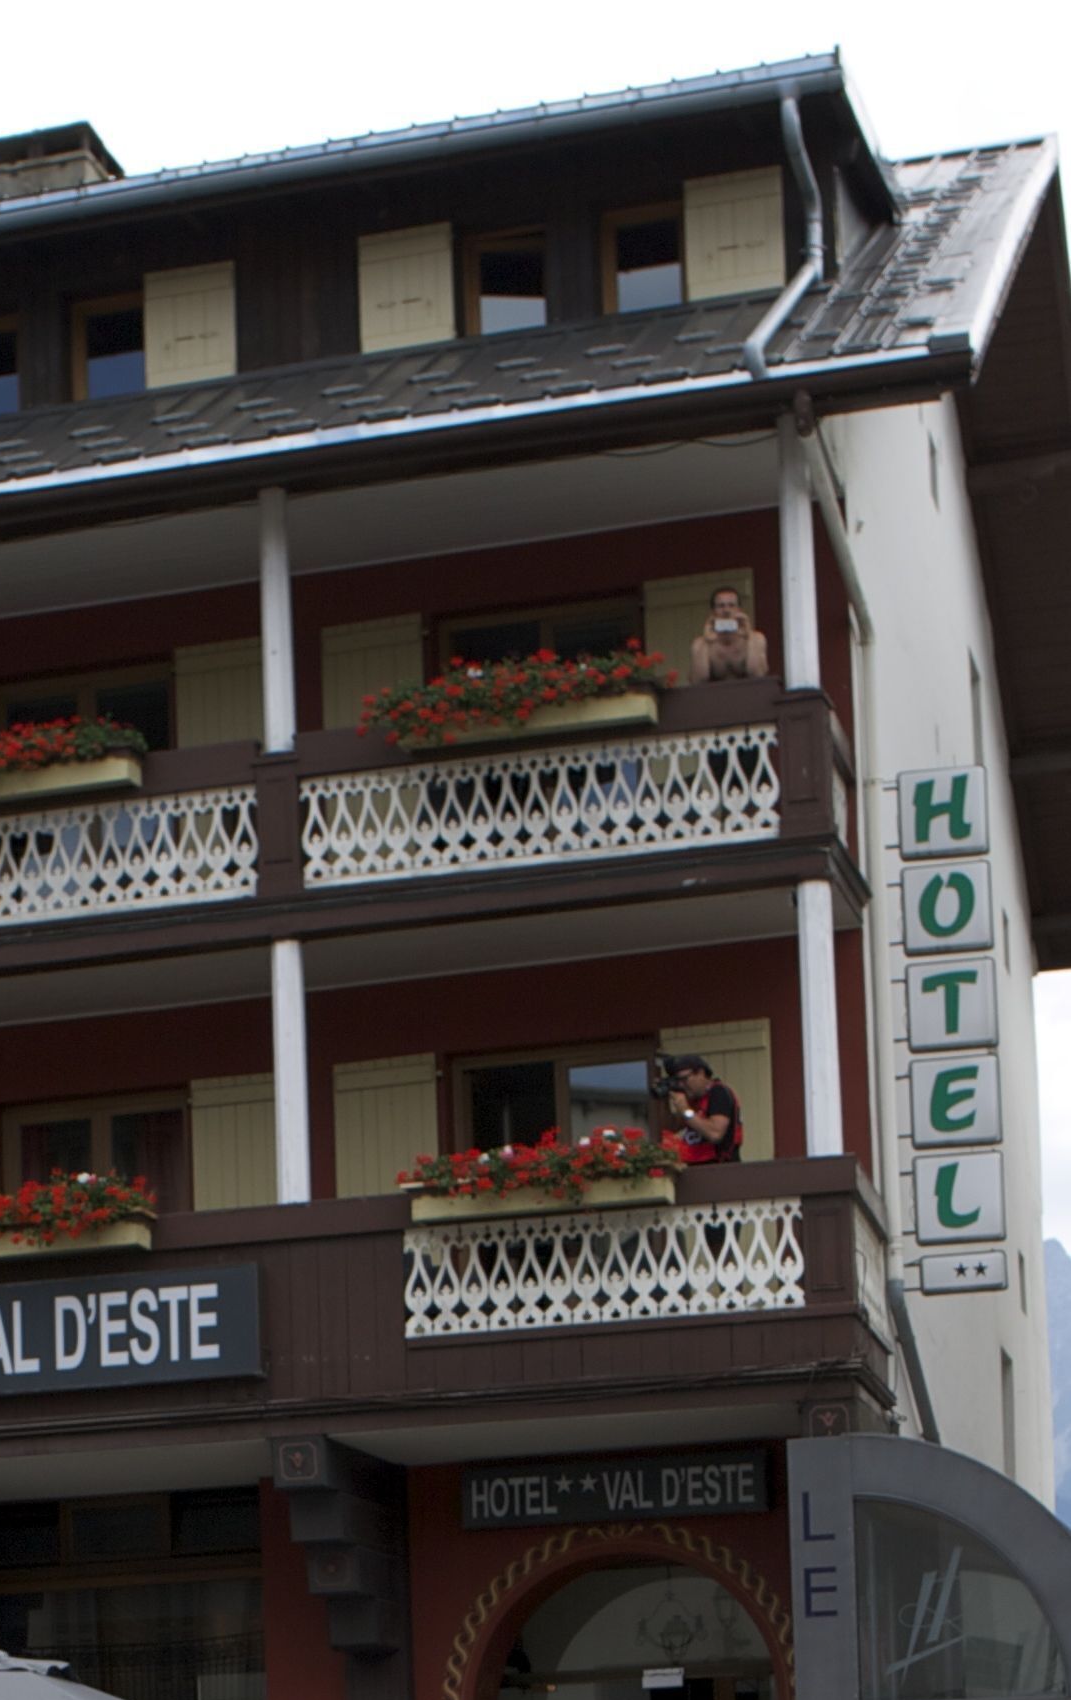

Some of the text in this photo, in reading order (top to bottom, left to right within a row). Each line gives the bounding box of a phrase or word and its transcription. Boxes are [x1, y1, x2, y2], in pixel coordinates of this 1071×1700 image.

[913, 773, 981, 1229] HOTEL
[54, 1282, 220, 1370] D'ESTE
[471, 1463, 755, 1518] HOTEL VAL D'ESTE
[801, 1491, 837, 1618] LE
